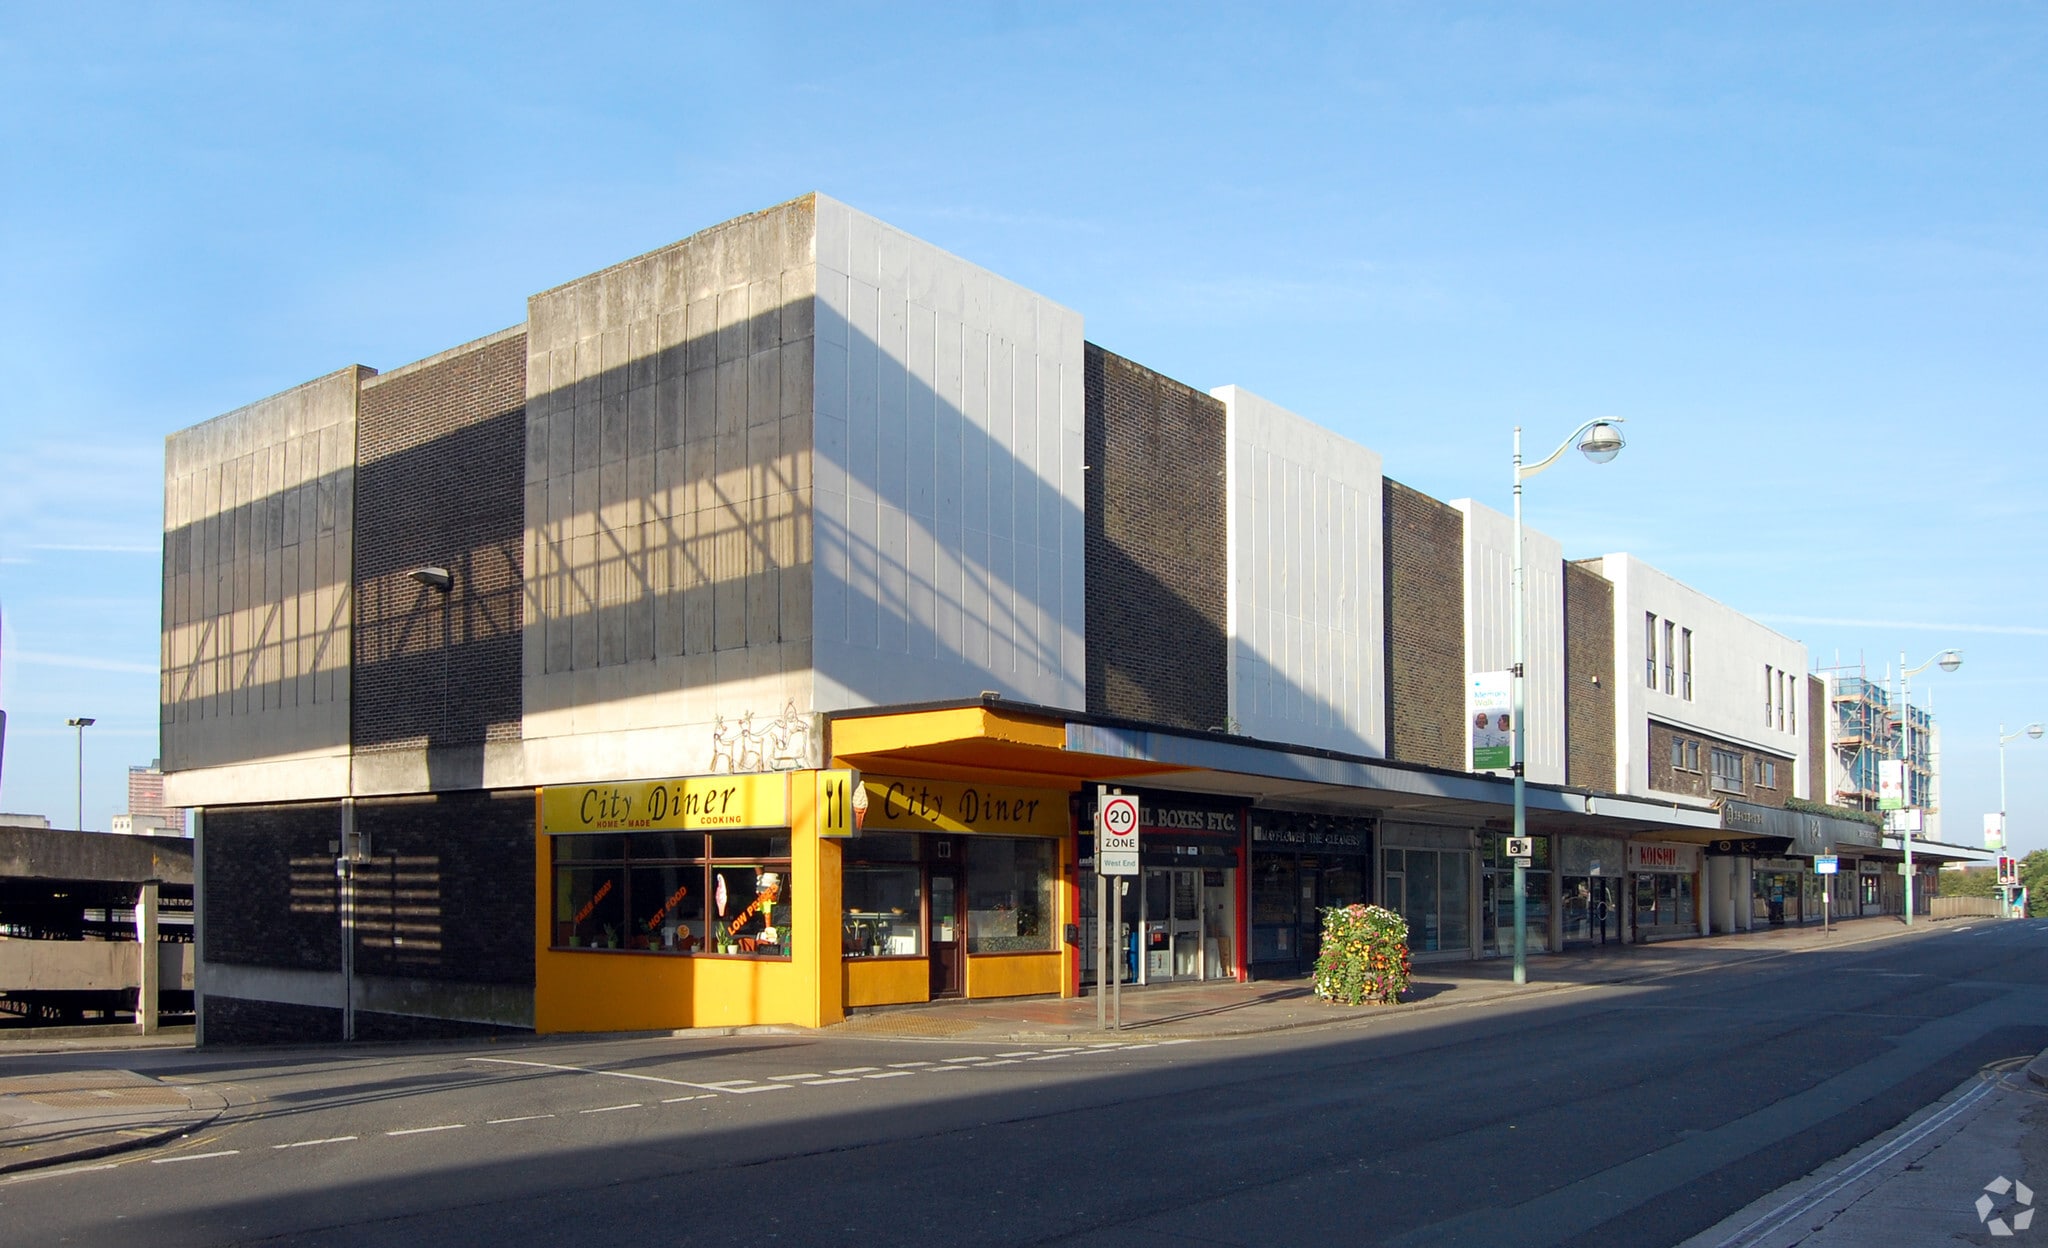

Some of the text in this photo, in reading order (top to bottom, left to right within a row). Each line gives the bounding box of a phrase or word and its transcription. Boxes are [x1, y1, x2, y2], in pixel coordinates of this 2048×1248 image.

[580, 785, 736, 824] City Diner
[884, 782, 1039, 823] City Diner
[596, 819, 619, 829] HOME
[628, 819, 651, 828] MADE
[700, 815, 742, 825] COOKING
[1110, 810, 1131, 824] 20
[1158, 808, 1204, 829] BOXES
[1207, 812, 1236, 831] ETC.
[1105, 838, 1135, 848] ZONE
[592, 879, 613, 905] AWAY
[647, 884, 688, 930] HOT FOOD
[727, 911, 748, 936] LOW
